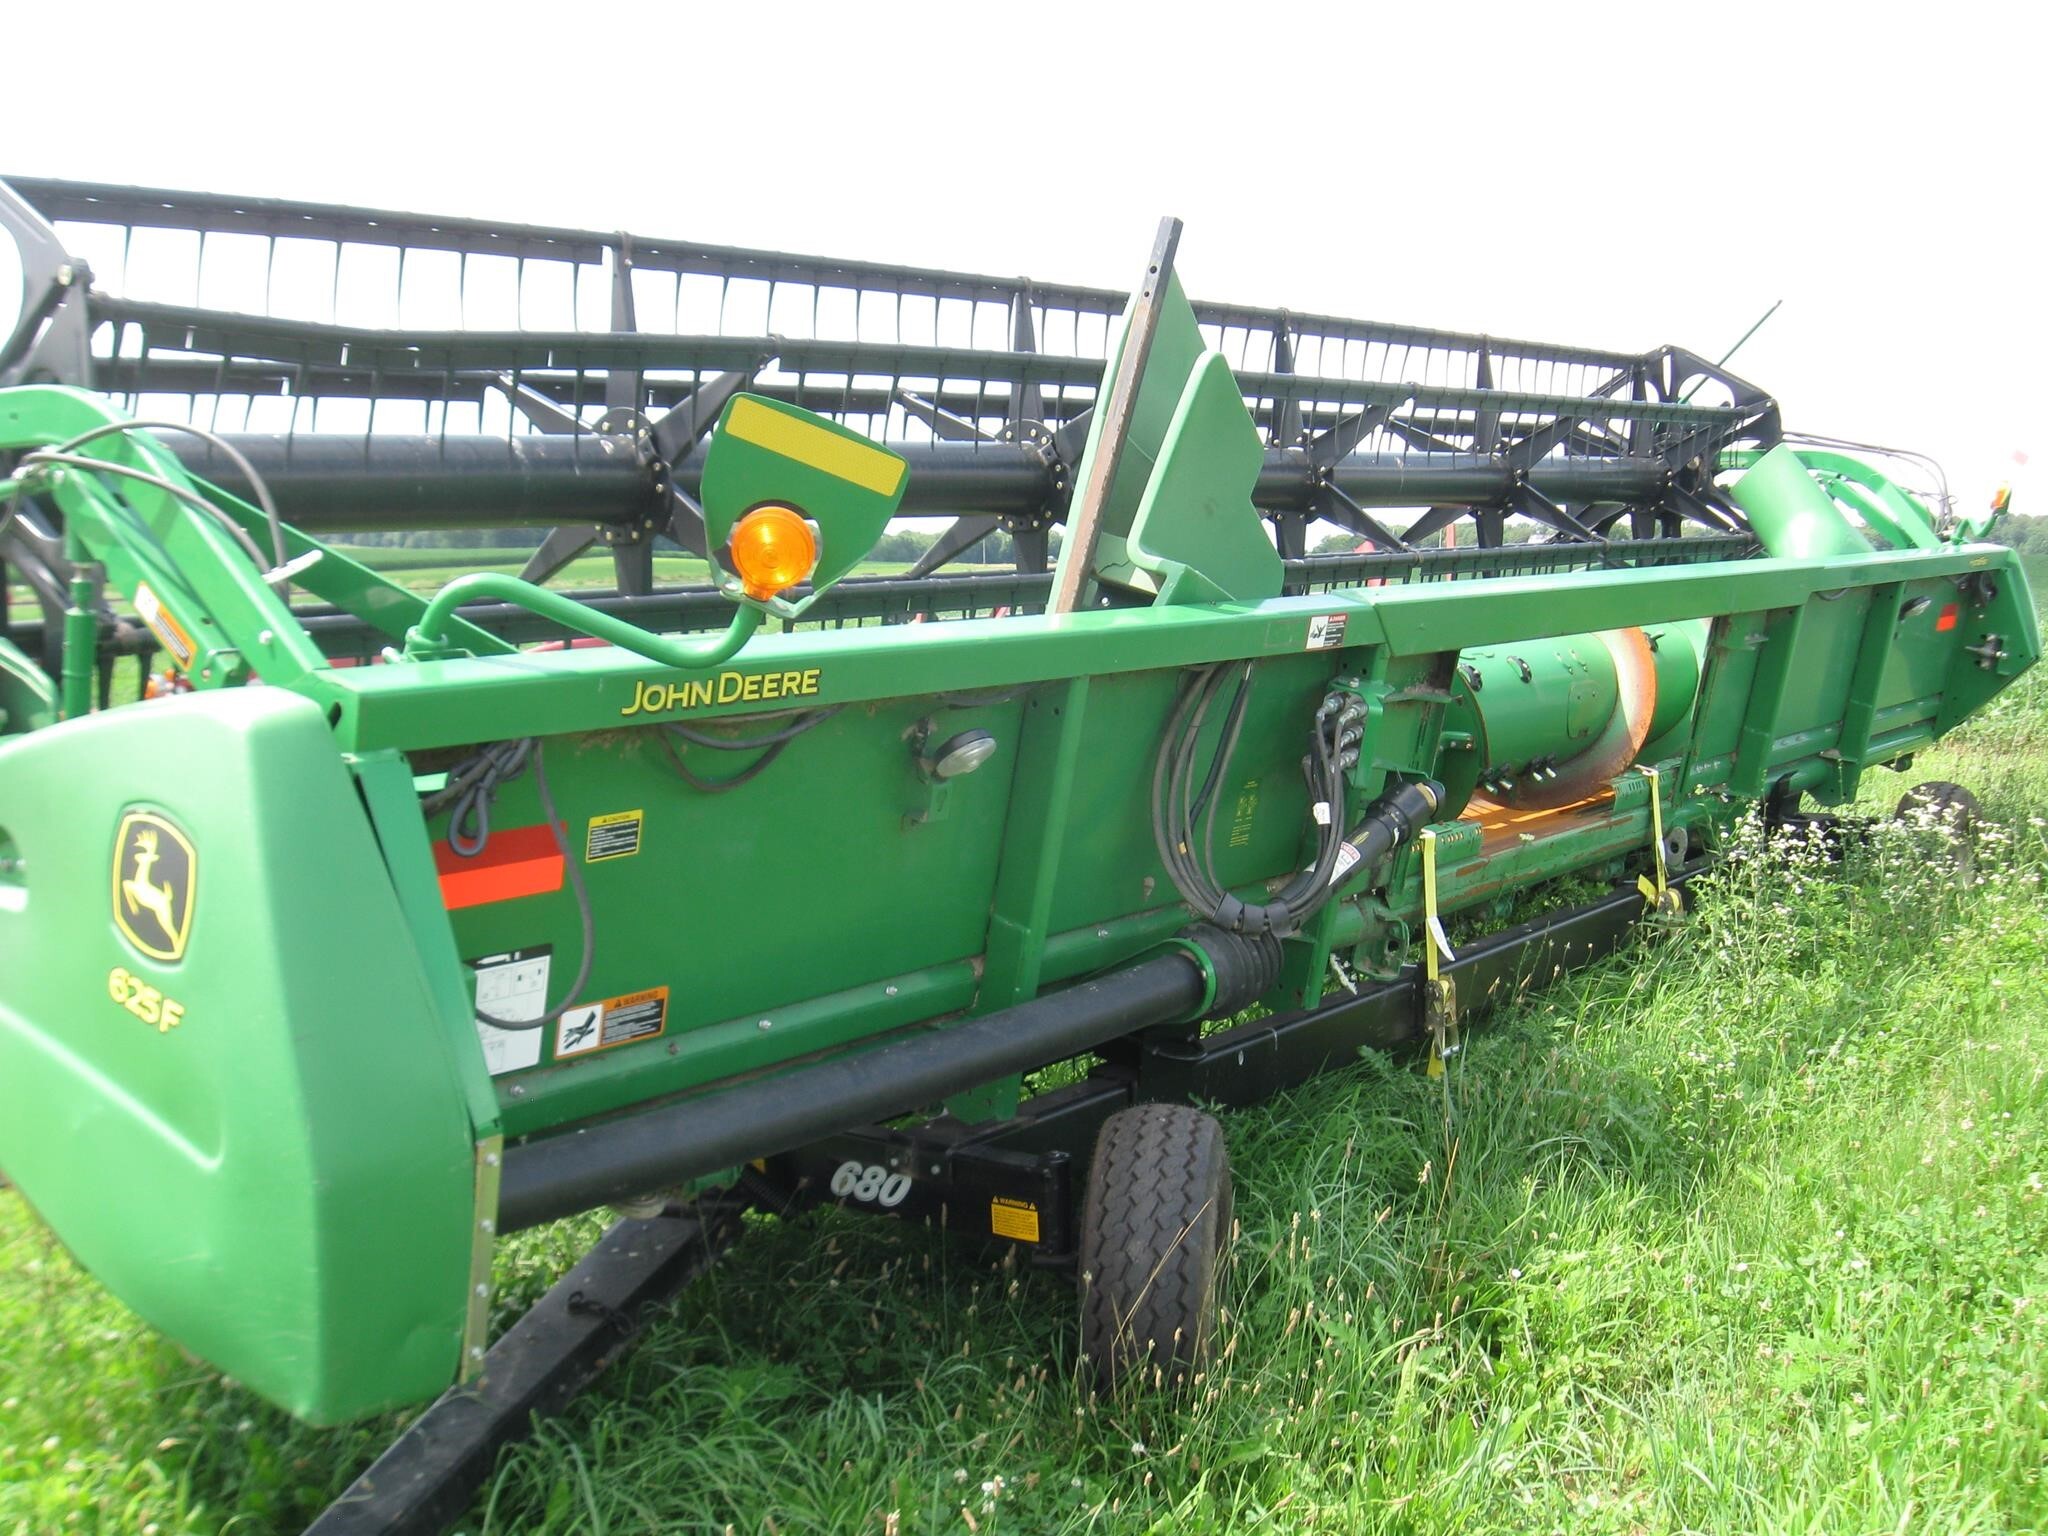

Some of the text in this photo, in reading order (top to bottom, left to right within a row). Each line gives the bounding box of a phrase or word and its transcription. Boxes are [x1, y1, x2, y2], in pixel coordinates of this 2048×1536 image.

[108, 967, 185, 1033] 625F
[830, 1160, 912, 1207] 680
[999, 1197, 1029, 1209] WARNING
